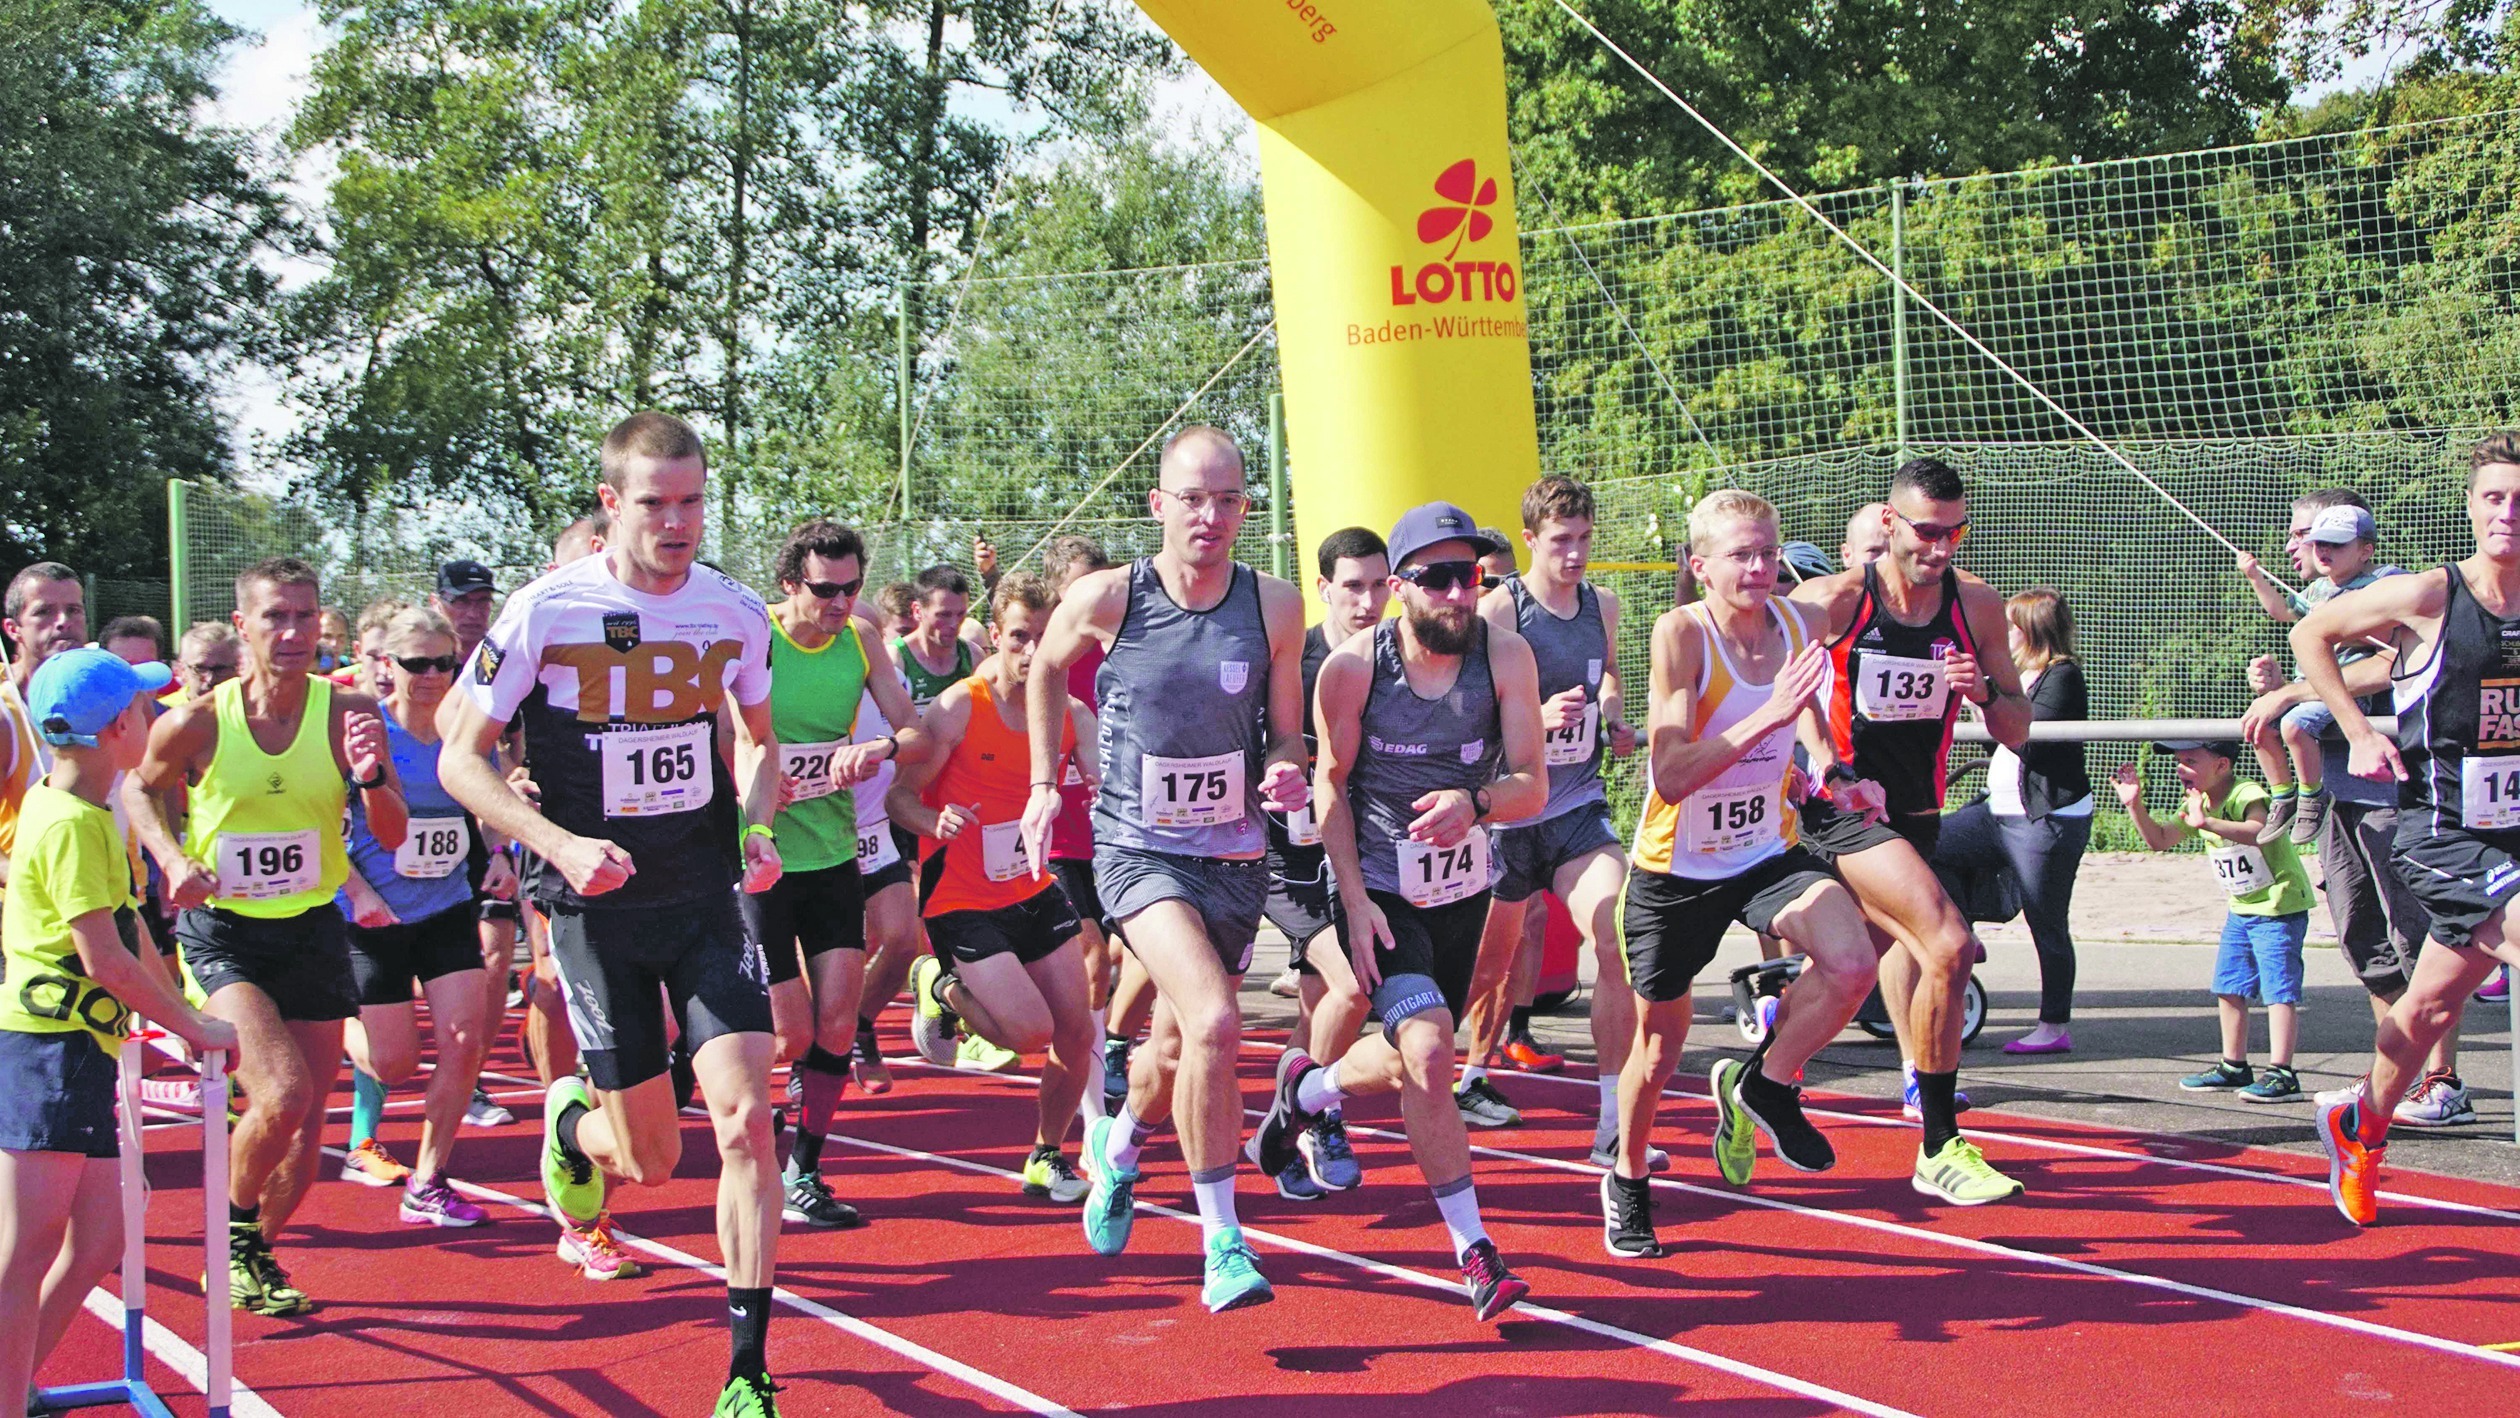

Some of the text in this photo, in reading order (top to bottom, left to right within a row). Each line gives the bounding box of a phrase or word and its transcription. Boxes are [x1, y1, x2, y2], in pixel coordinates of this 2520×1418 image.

[1391, 261, 1515, 306] LOTTO
[606, 626, 639, 639] TBC
[538, 638, 744, 723] TBC
[1877, 669, 1935, 700] 133
[627, 742, 695, 785] 165
[1384, 743, 1428, 755] EDAG
[1161, 769, 1227, 802] 175
[1707, 795, 1766, 831] 158
[414, 829, 459, 856] 188
[857, 834, 878, 859] 98
[236, 844, 304, 876] 196
[1417, 843, 1474, 883] 174
[2214, 854, 2254, 878] 374
[1383, 990, 1436, 1028] STUTTGART
